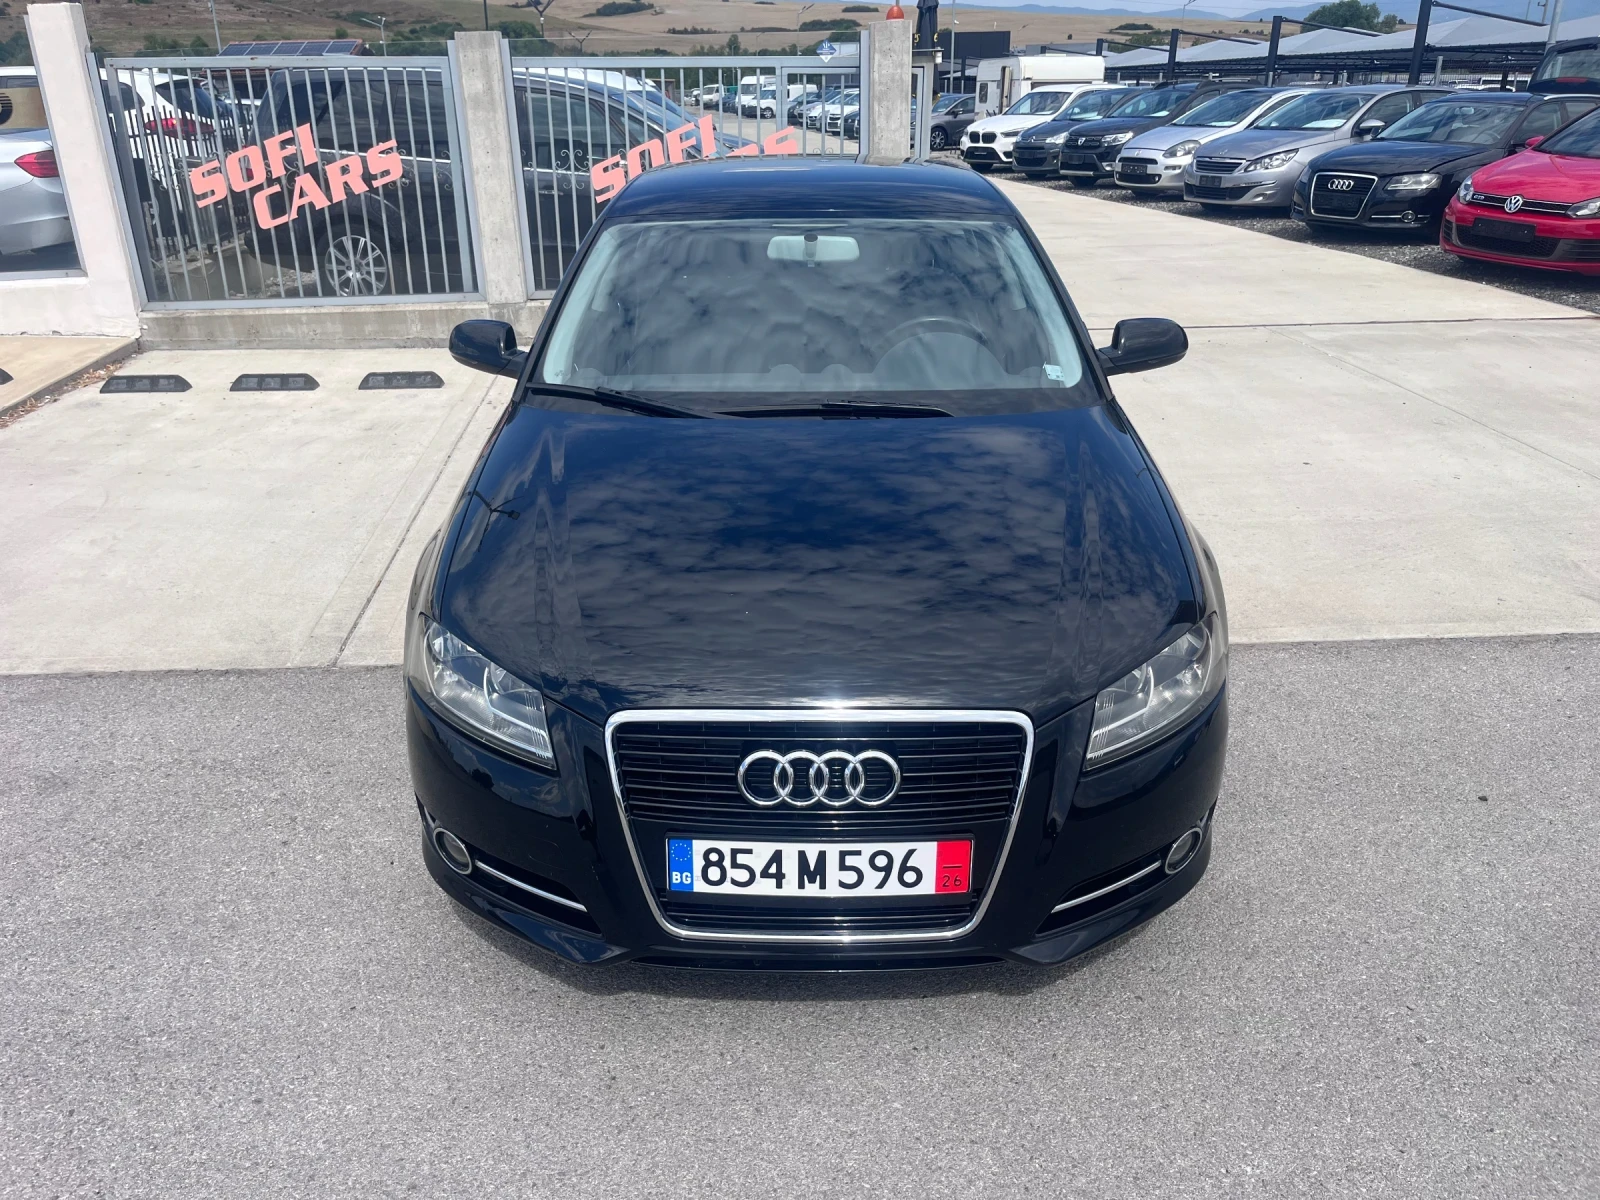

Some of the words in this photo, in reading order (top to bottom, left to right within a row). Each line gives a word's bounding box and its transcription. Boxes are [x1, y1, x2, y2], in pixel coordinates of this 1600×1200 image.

[190, 123, 318, 208] SOFI
[253, 139, 403, 229] CARS
[591, 114, 716, 203] SOFI
[672, 871, 691, 884] BG
[701, 847, 785, 889] 854
[798, 850, 826, 889] M
[838, 848, 923, 889] 596
[942, 874, 962, 888] 26
